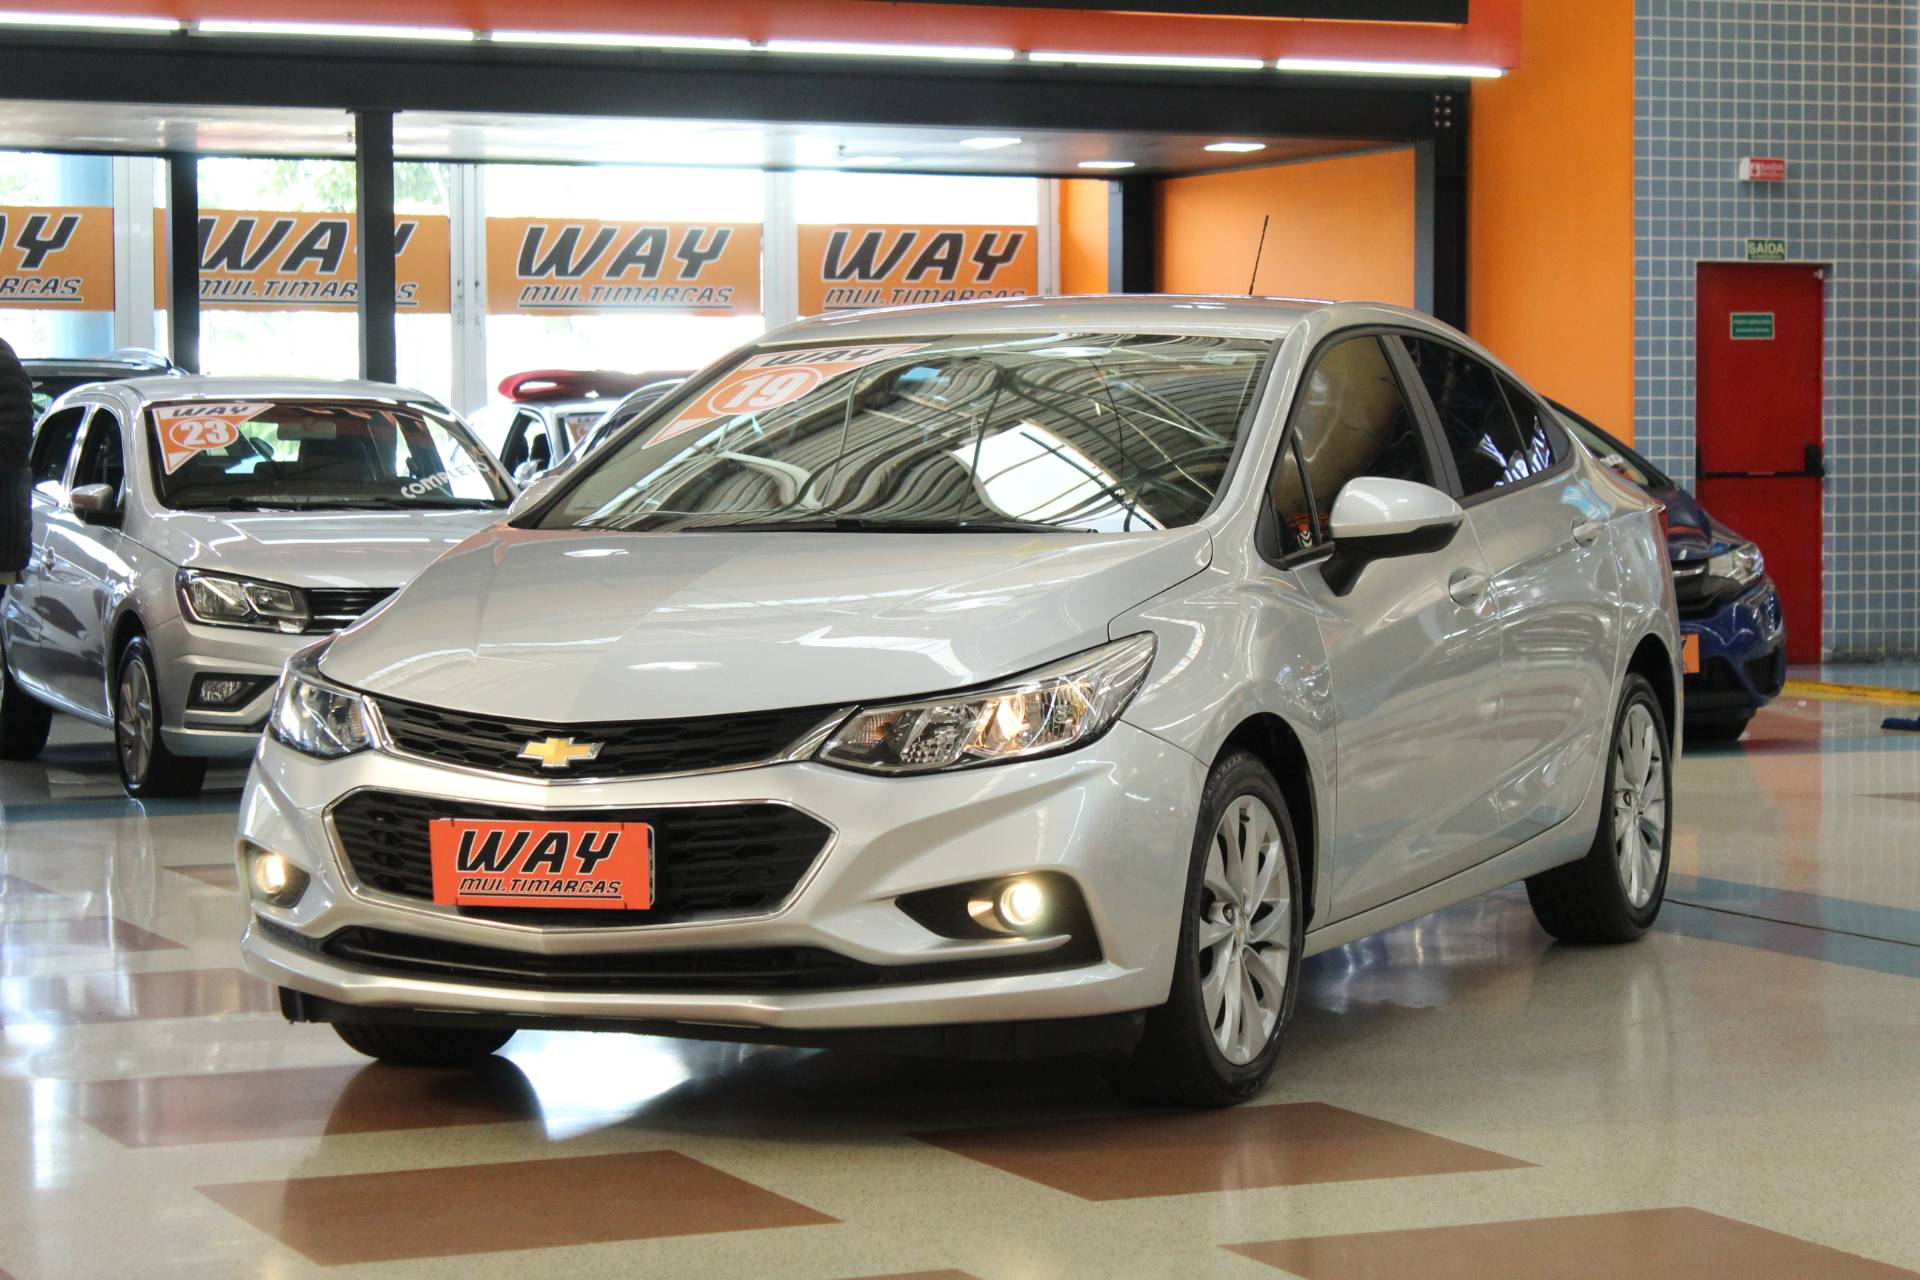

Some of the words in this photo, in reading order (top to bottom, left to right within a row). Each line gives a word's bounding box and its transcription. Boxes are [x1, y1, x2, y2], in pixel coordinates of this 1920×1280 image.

[198, 217, 418, 275] WA
[516, 225, 734, 281] WAY
[822, 230, 1026, 283] WAY
[1748, 239, 1785, 255] SAÍDA
[519, 284, 734, 304] MULTIMARCAS
[759, 349, 884, 368] WAY
[722, 370, 812, 409] 19
[172, 406, 248, 417] WAY
[180, 420, 230, 446] 23
[456, 829, 621, 876] WAY
[459, 877, 623, 895] MULTIMARCAS
